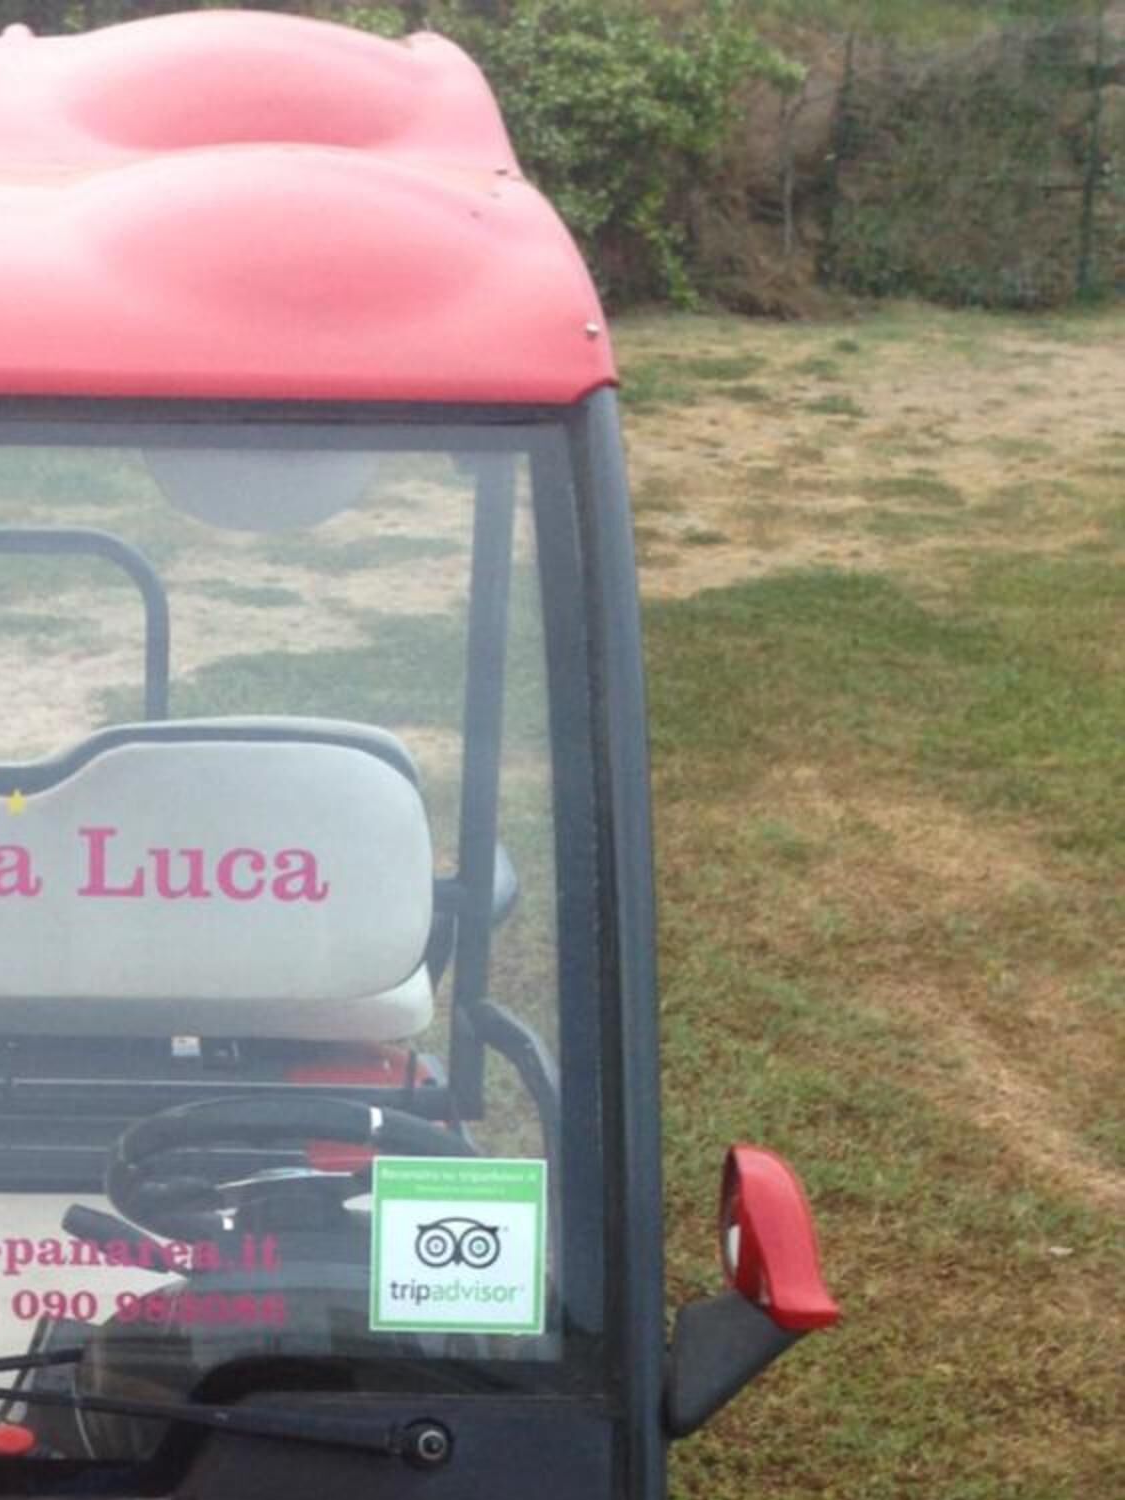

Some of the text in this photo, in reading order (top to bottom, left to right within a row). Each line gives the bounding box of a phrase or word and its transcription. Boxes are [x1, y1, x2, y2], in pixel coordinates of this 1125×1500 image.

[76, 827, 330, 903] Luca
[11, 1290, 99, 1322] 090
[390, 1280, 518, 1306] tripadvisor
